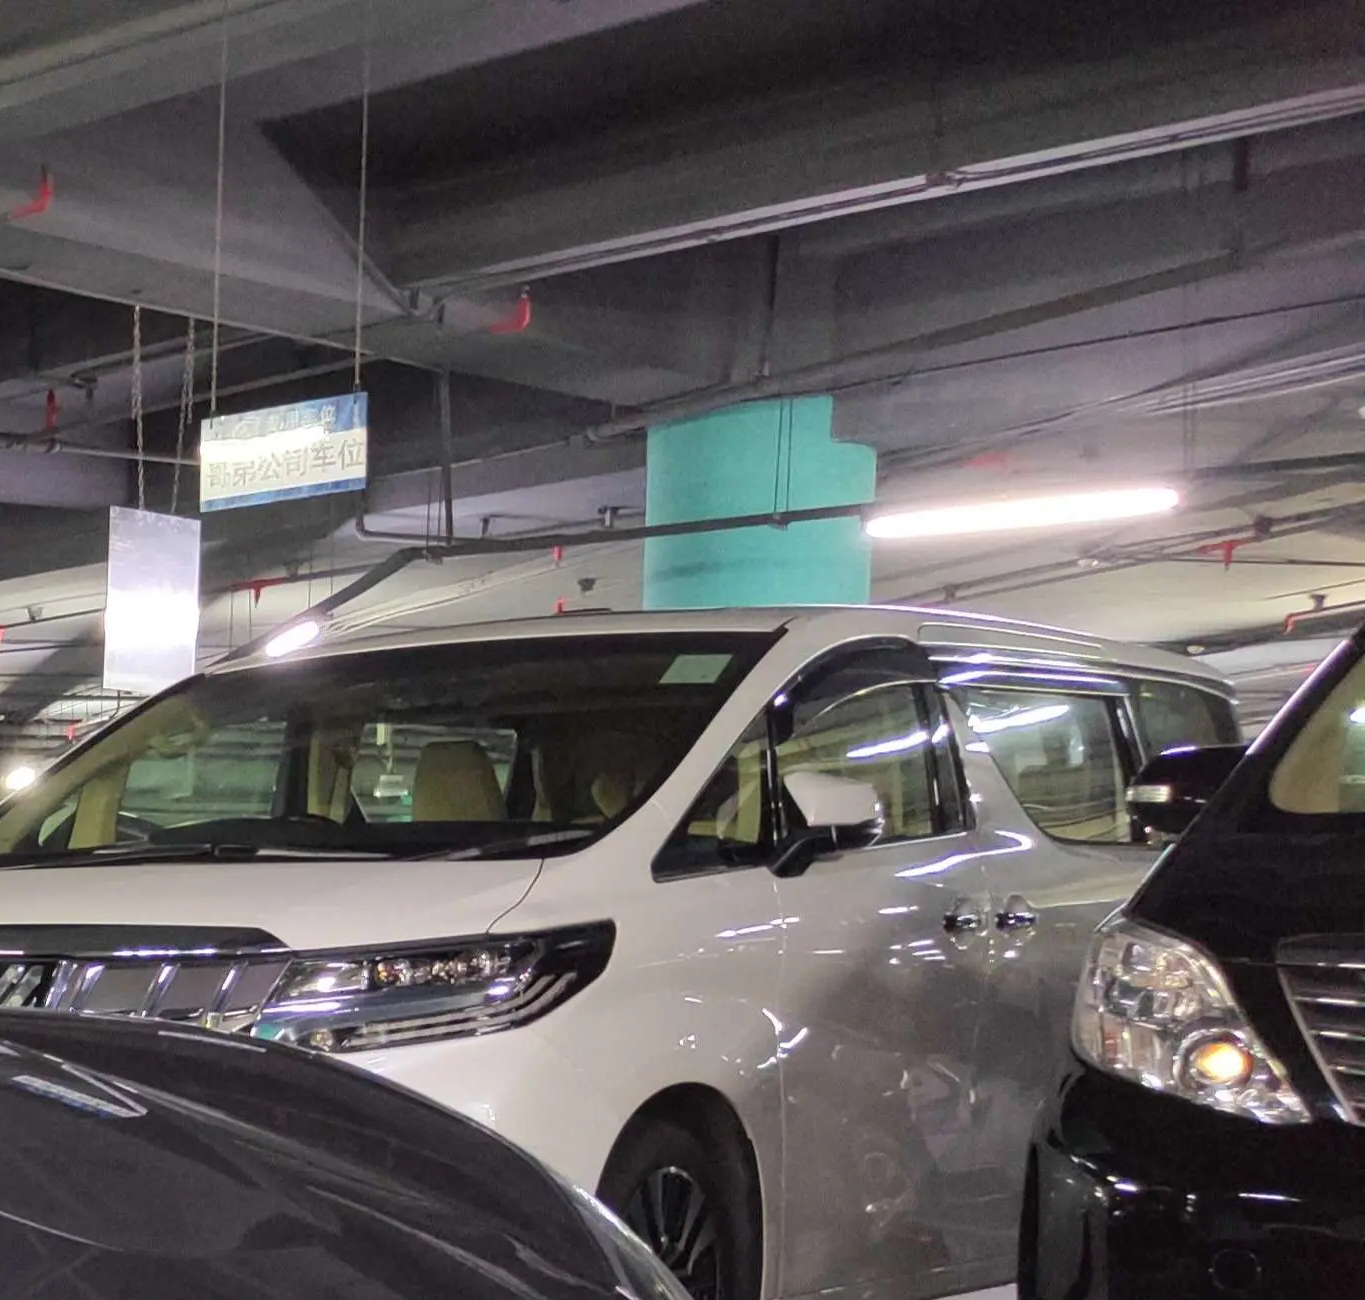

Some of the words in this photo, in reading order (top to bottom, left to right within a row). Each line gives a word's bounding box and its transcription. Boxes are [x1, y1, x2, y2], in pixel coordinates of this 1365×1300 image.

[207, 437, 365, 488] 哥弟公司车位
